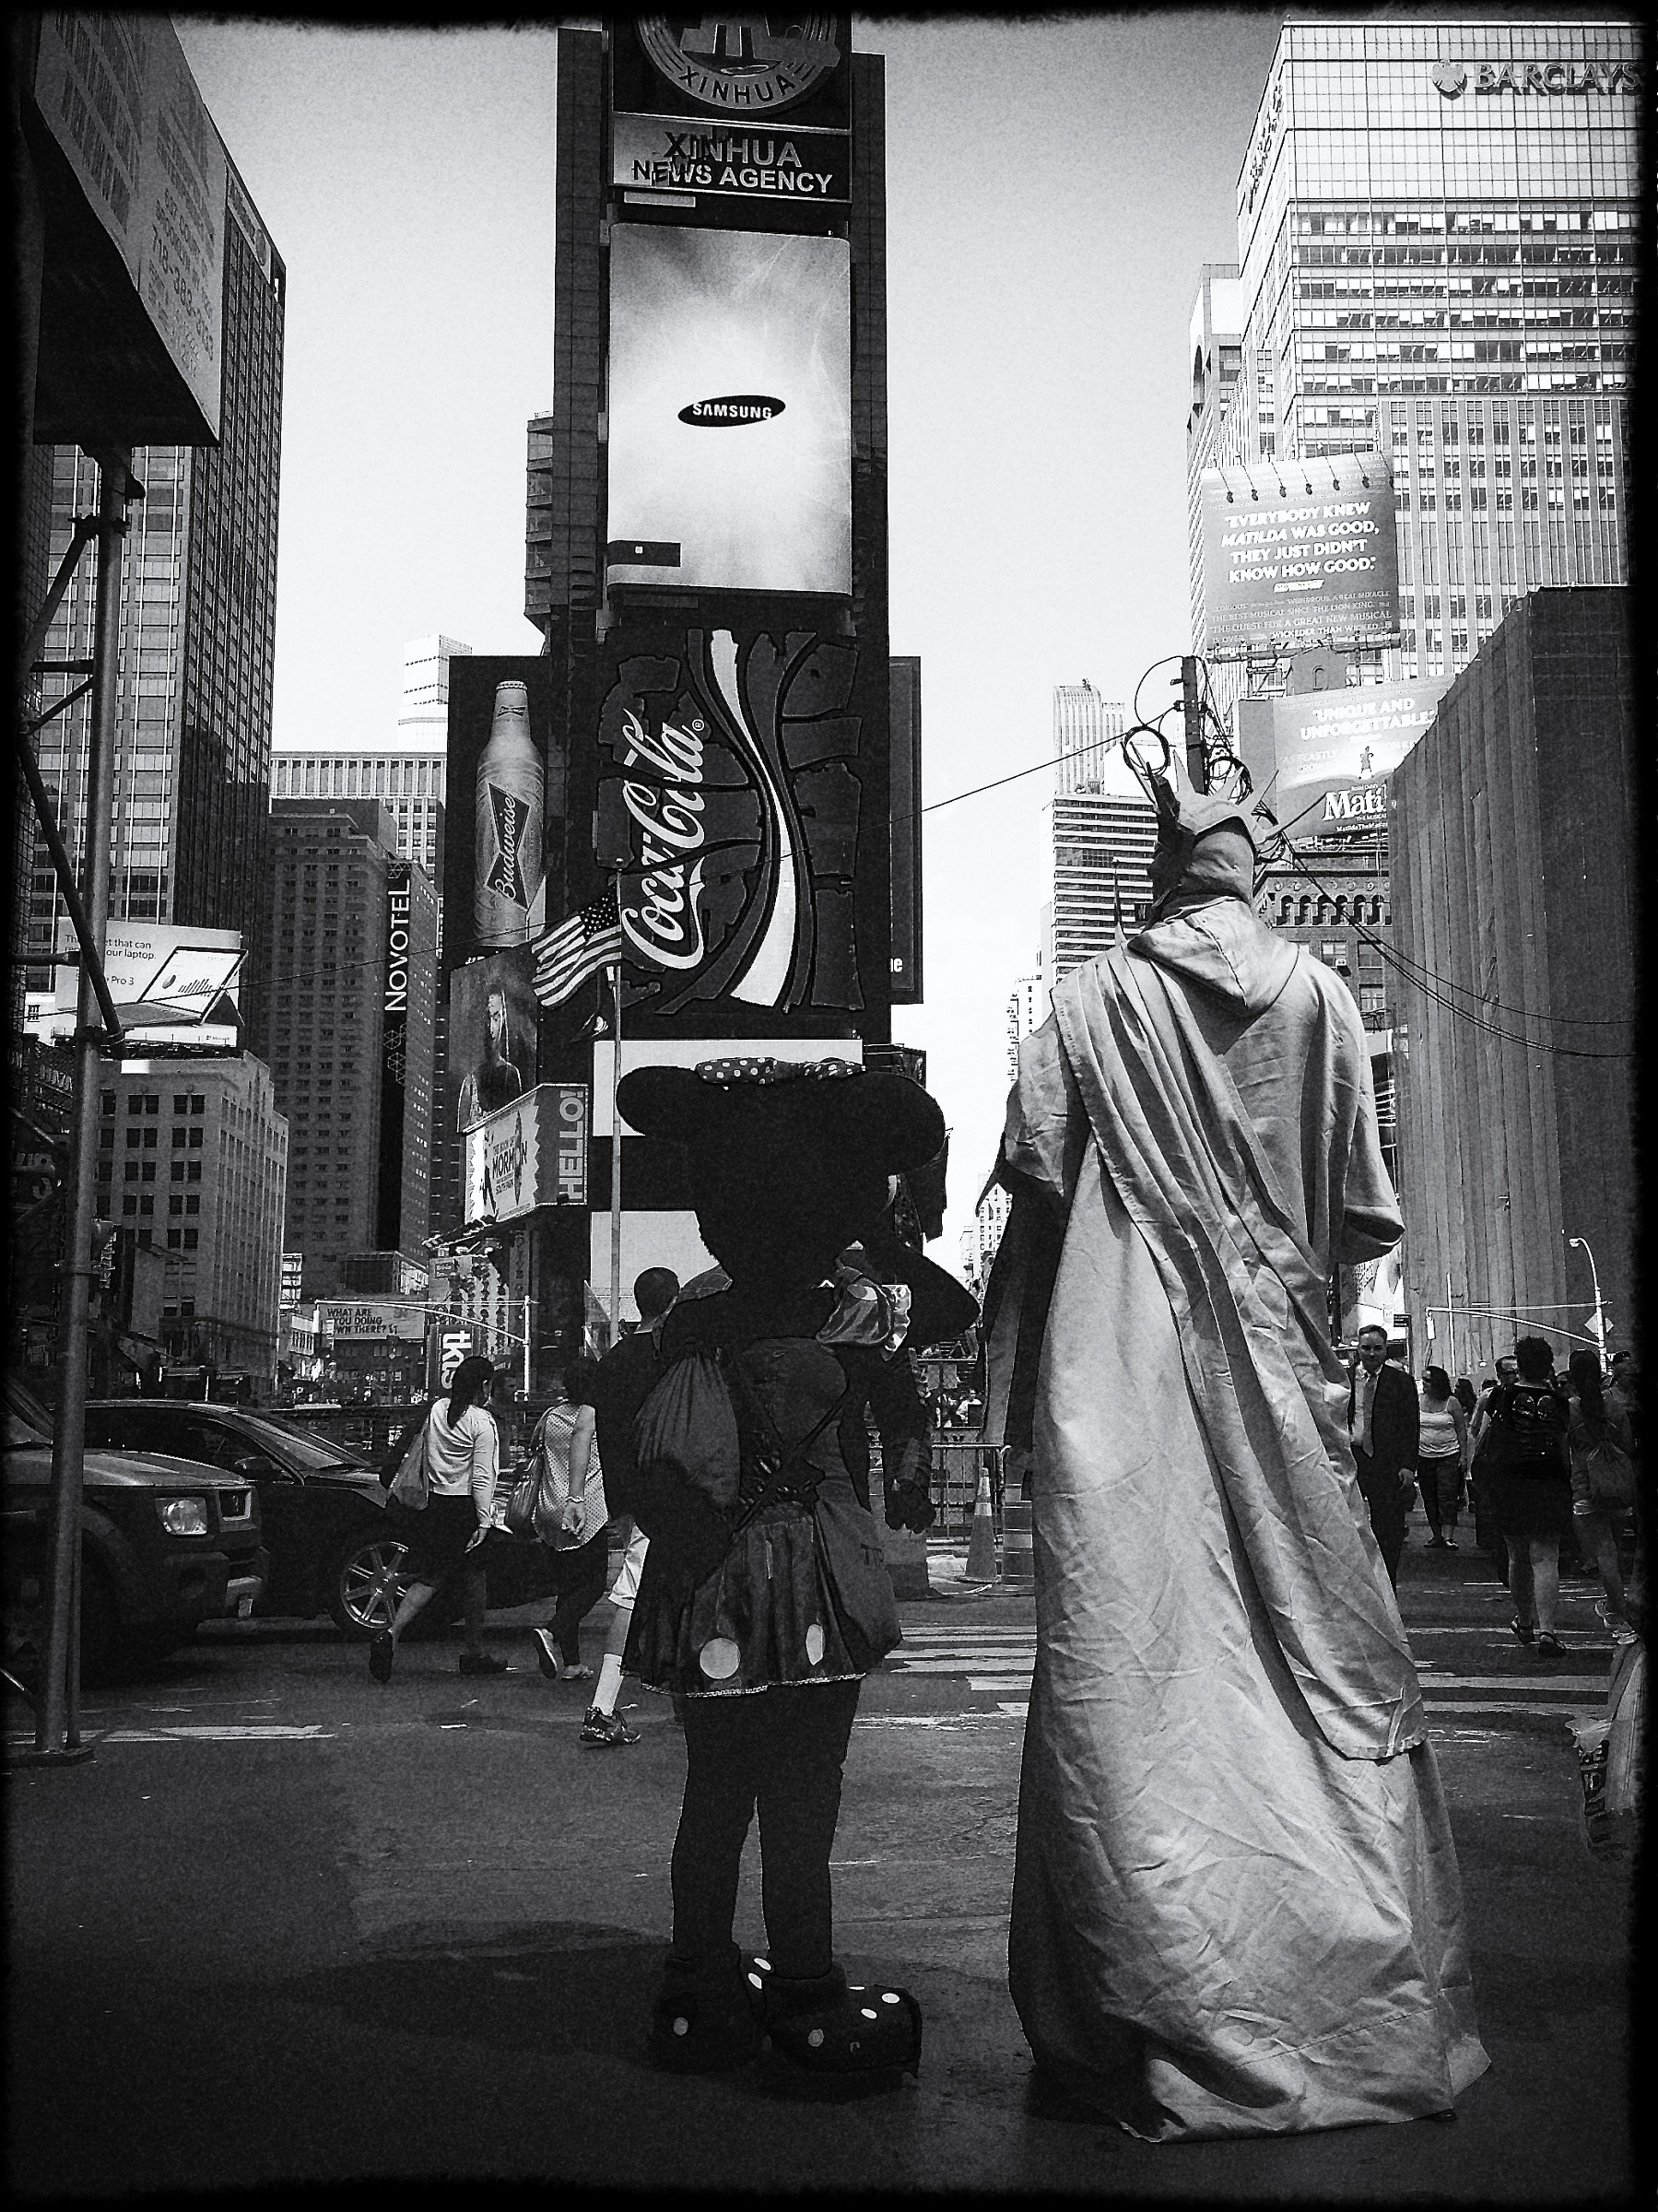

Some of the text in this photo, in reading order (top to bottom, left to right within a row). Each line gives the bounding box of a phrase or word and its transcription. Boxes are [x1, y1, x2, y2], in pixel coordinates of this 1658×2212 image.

[678, 65, 797, 104] XINHUA
[1474, 62, 1641, 90] BARCLAYS
[664, 131, 802, 168] XINHUA
[631, 159, 833, 194] NEWS AGENCY
[692, 402, 772, 419] SAMSUNG
[1323, 500, 1371, 518] KNEW
[1221, 520, 1380, 547] MATILDA WAS GOOD,
[1229, 538, 1368, 564] THEY JUST DIDN'T
[1229, 565, 1279, 583] KNOW
[1281, 561, 1322, 578] HOW
[1232, 622, 1260, 631] QUEST
[1264, 619, 1282, 629] FOR
[1326, 614, 1347, 623] NEW
[1350, 610, 1392, 621] MUSICAL
[1317, 625, 1342, 634] THAN
[1379, 697, 1416, 714] AND
[621, 707, 706, 970] Coca-Cola
[65, 934, 152, 949] Th that can
[383, 878, 410, 1011] NOVOTEL
[124, 948, 157, 960] laptop.
[111, 975, 135, 985] Pro 3
[559, 1089, 584, 1199] HELLO!
[327, 1308, 372, 1317] WHAT ARE
[334, 1317, 383, 1325] YOU DOING
[354, 1325, 387, 1334] THERE?
